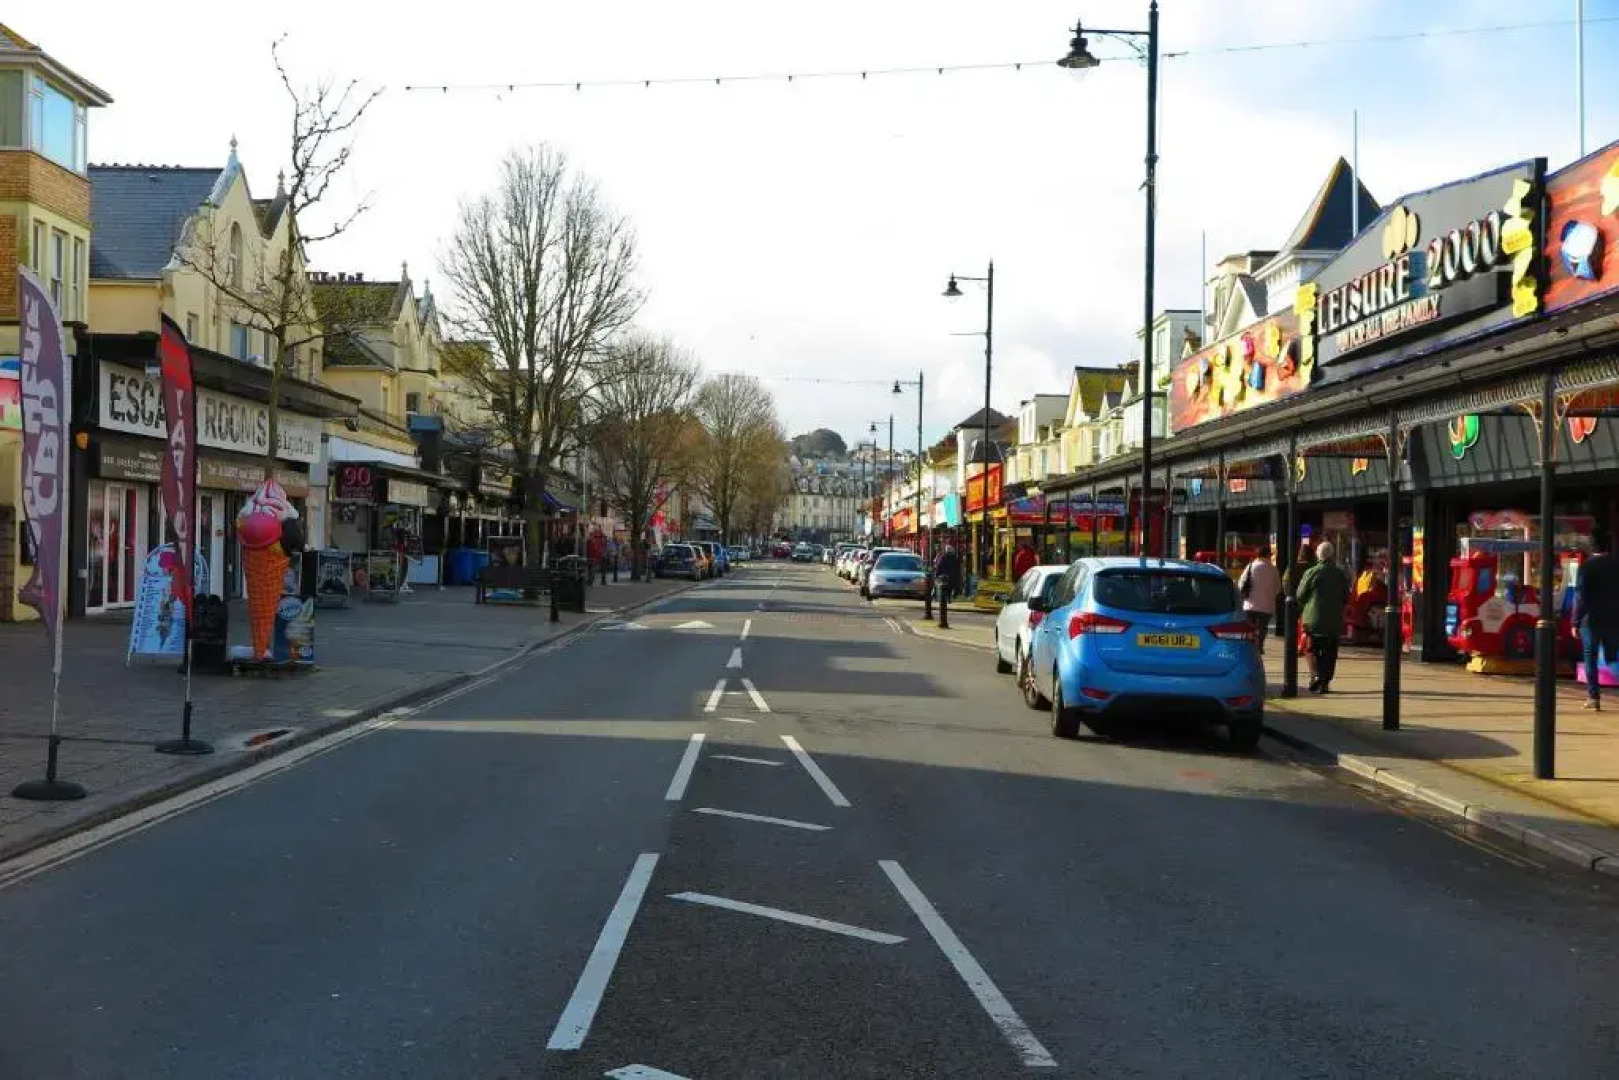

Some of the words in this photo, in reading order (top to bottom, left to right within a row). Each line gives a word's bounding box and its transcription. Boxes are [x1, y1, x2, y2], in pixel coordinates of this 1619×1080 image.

[1317, 255, 1410, 335] LEISURE
[1427, 211, 1501, 288] 2000
[109, 372, 167, 428] ESCA
[204, 397, 267, 448] ROOMS
